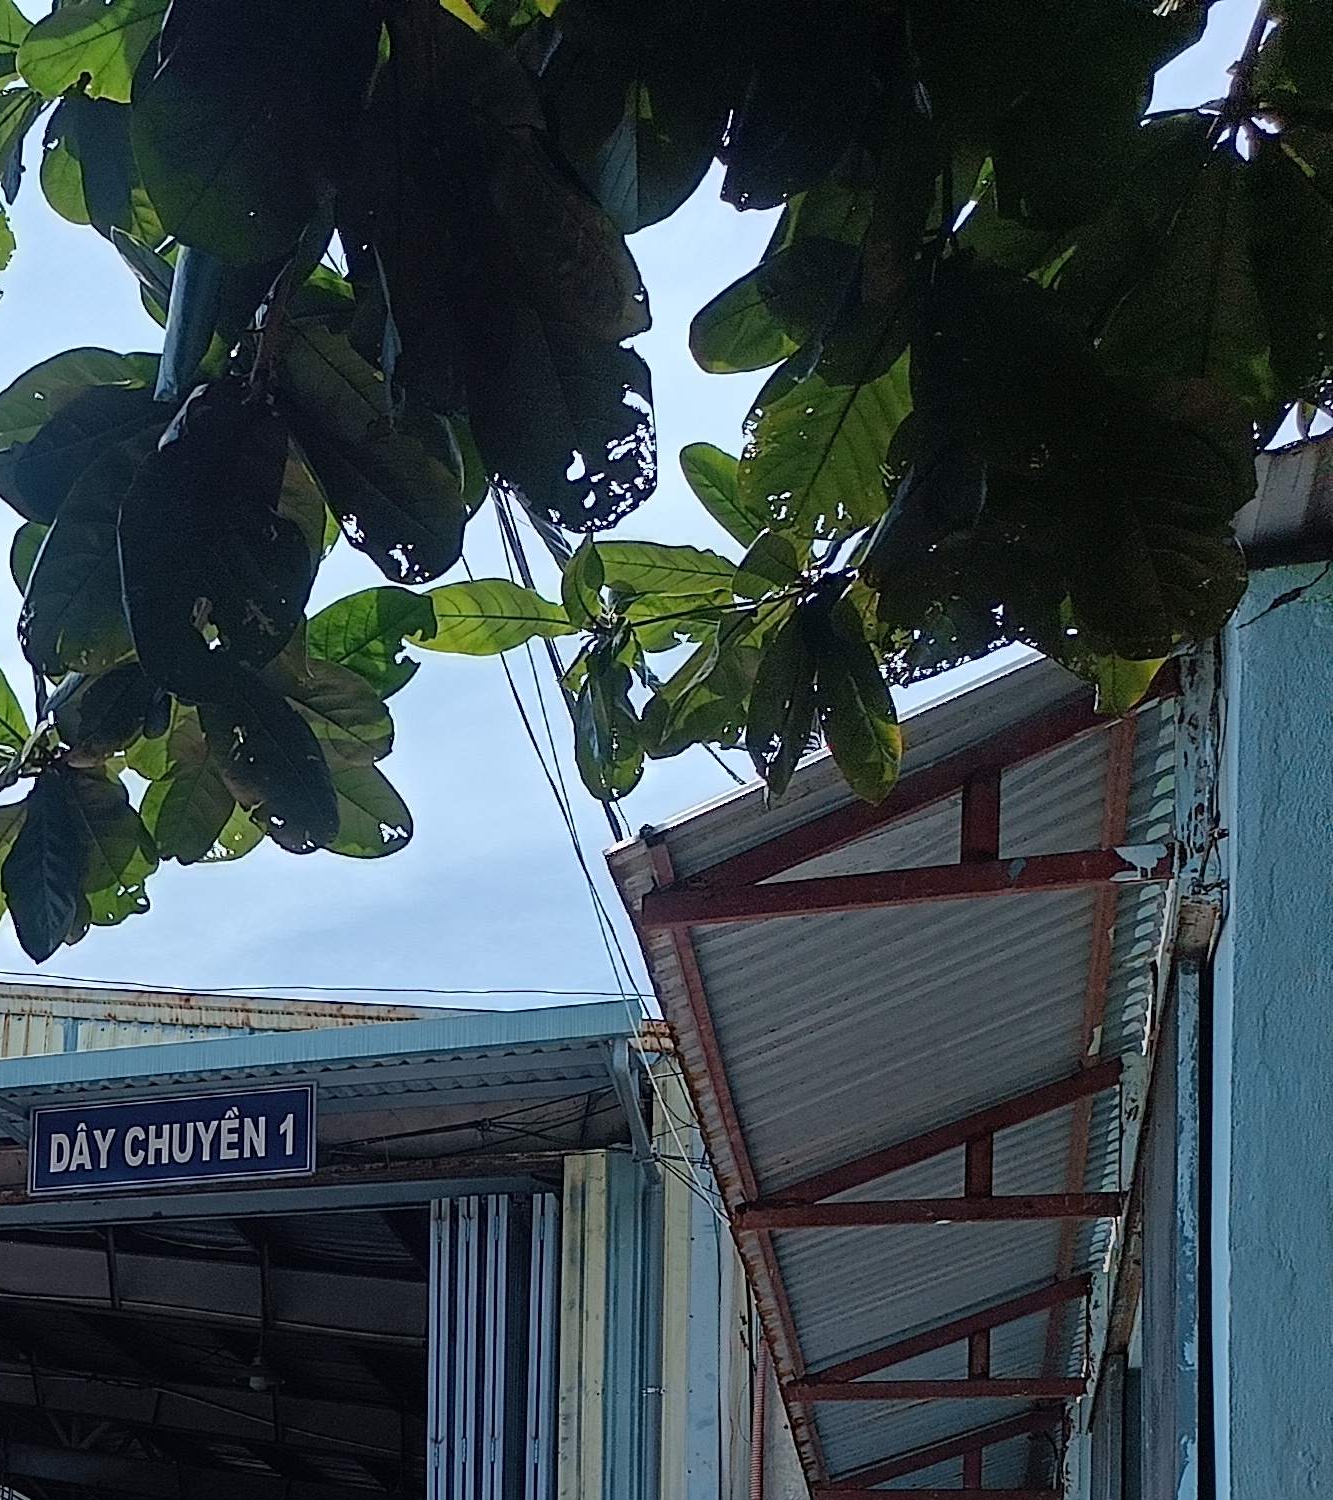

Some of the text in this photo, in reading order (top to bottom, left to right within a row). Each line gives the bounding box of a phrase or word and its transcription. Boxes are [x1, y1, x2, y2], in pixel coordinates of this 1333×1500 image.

[49, 1106, 294, 1173] DÂY CHUYỀN 1
